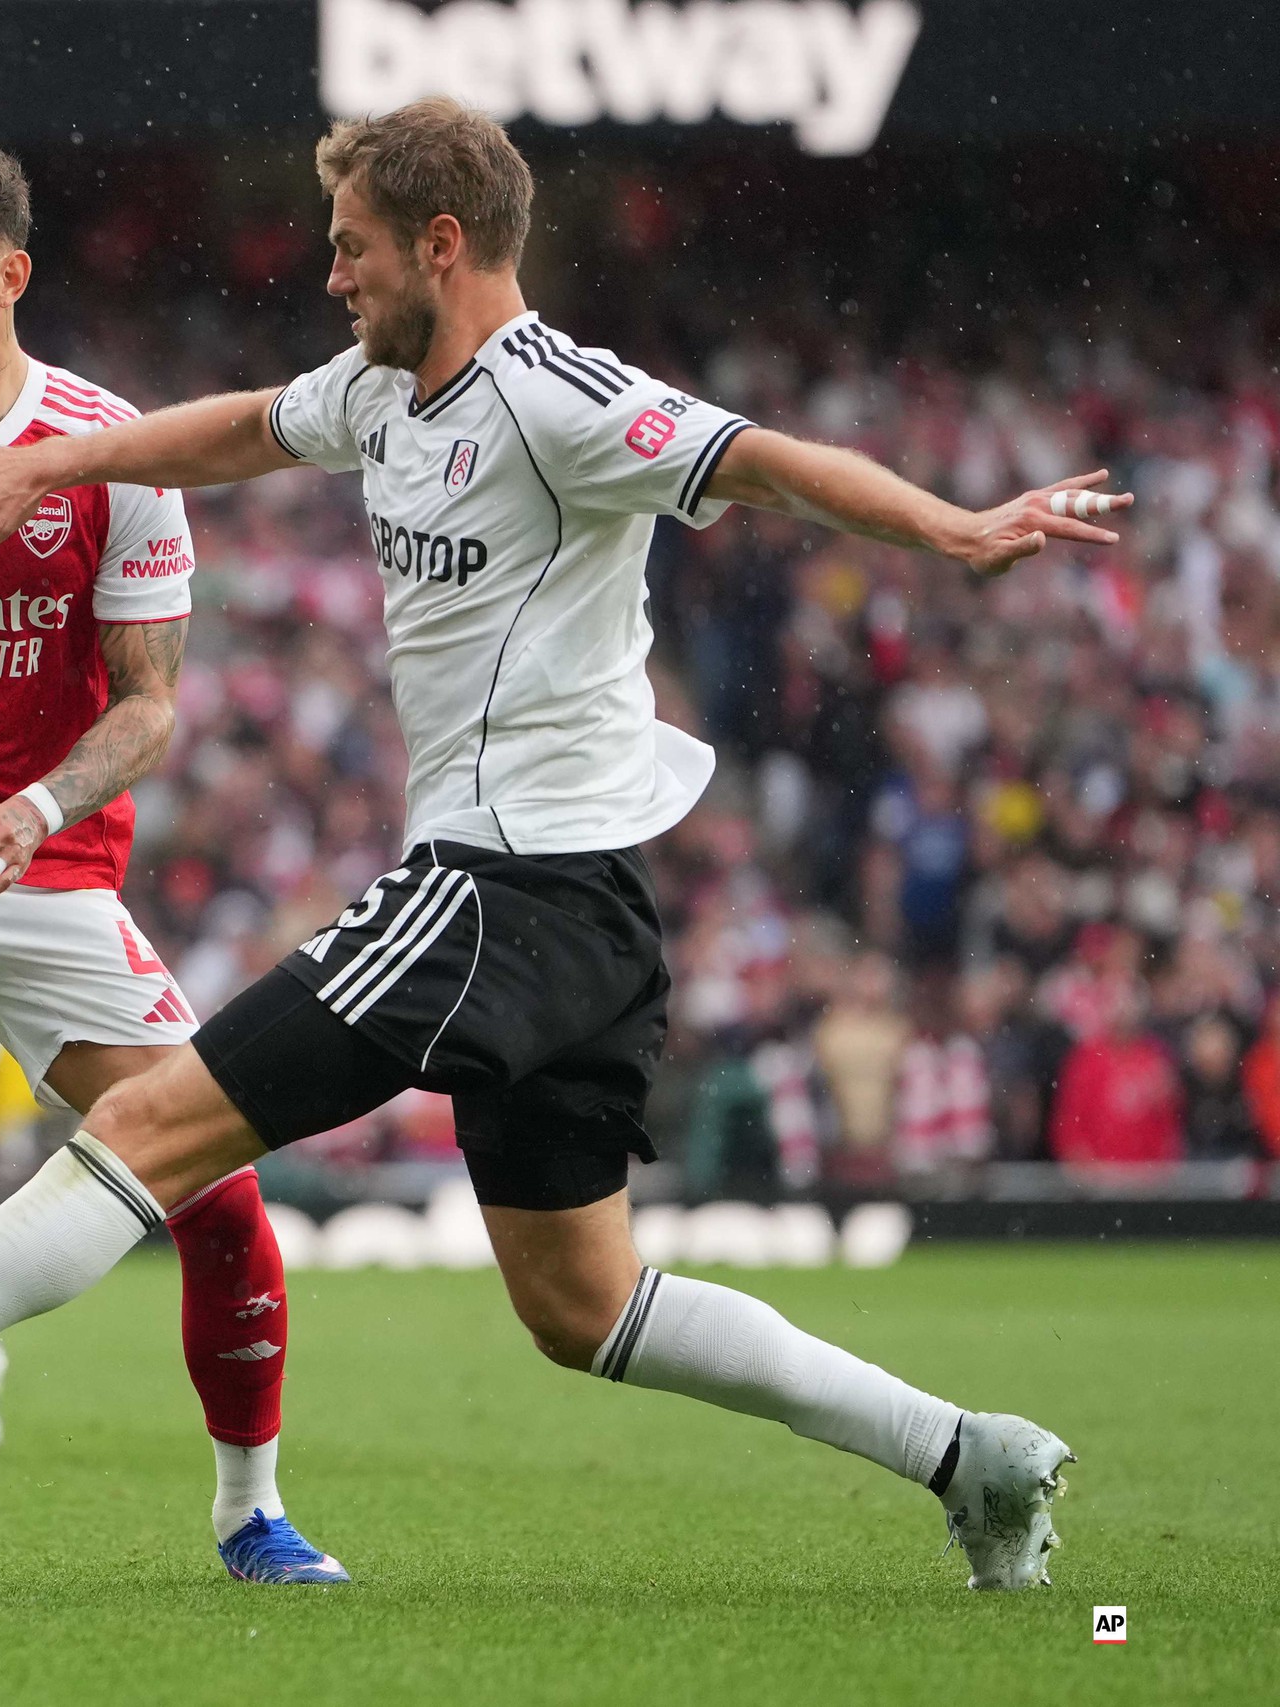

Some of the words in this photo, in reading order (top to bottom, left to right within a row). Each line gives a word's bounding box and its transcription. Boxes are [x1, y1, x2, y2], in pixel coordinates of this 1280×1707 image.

[318, 0, 920, 156] betway
[631, 415, 670, 454] Hi
[36, 506, 64, 516] senal
[147, 535, 182, 557] VISIT
[371, 512, 487, 586] SBOTOP
[122, 553, 194, 578] RWANDA
